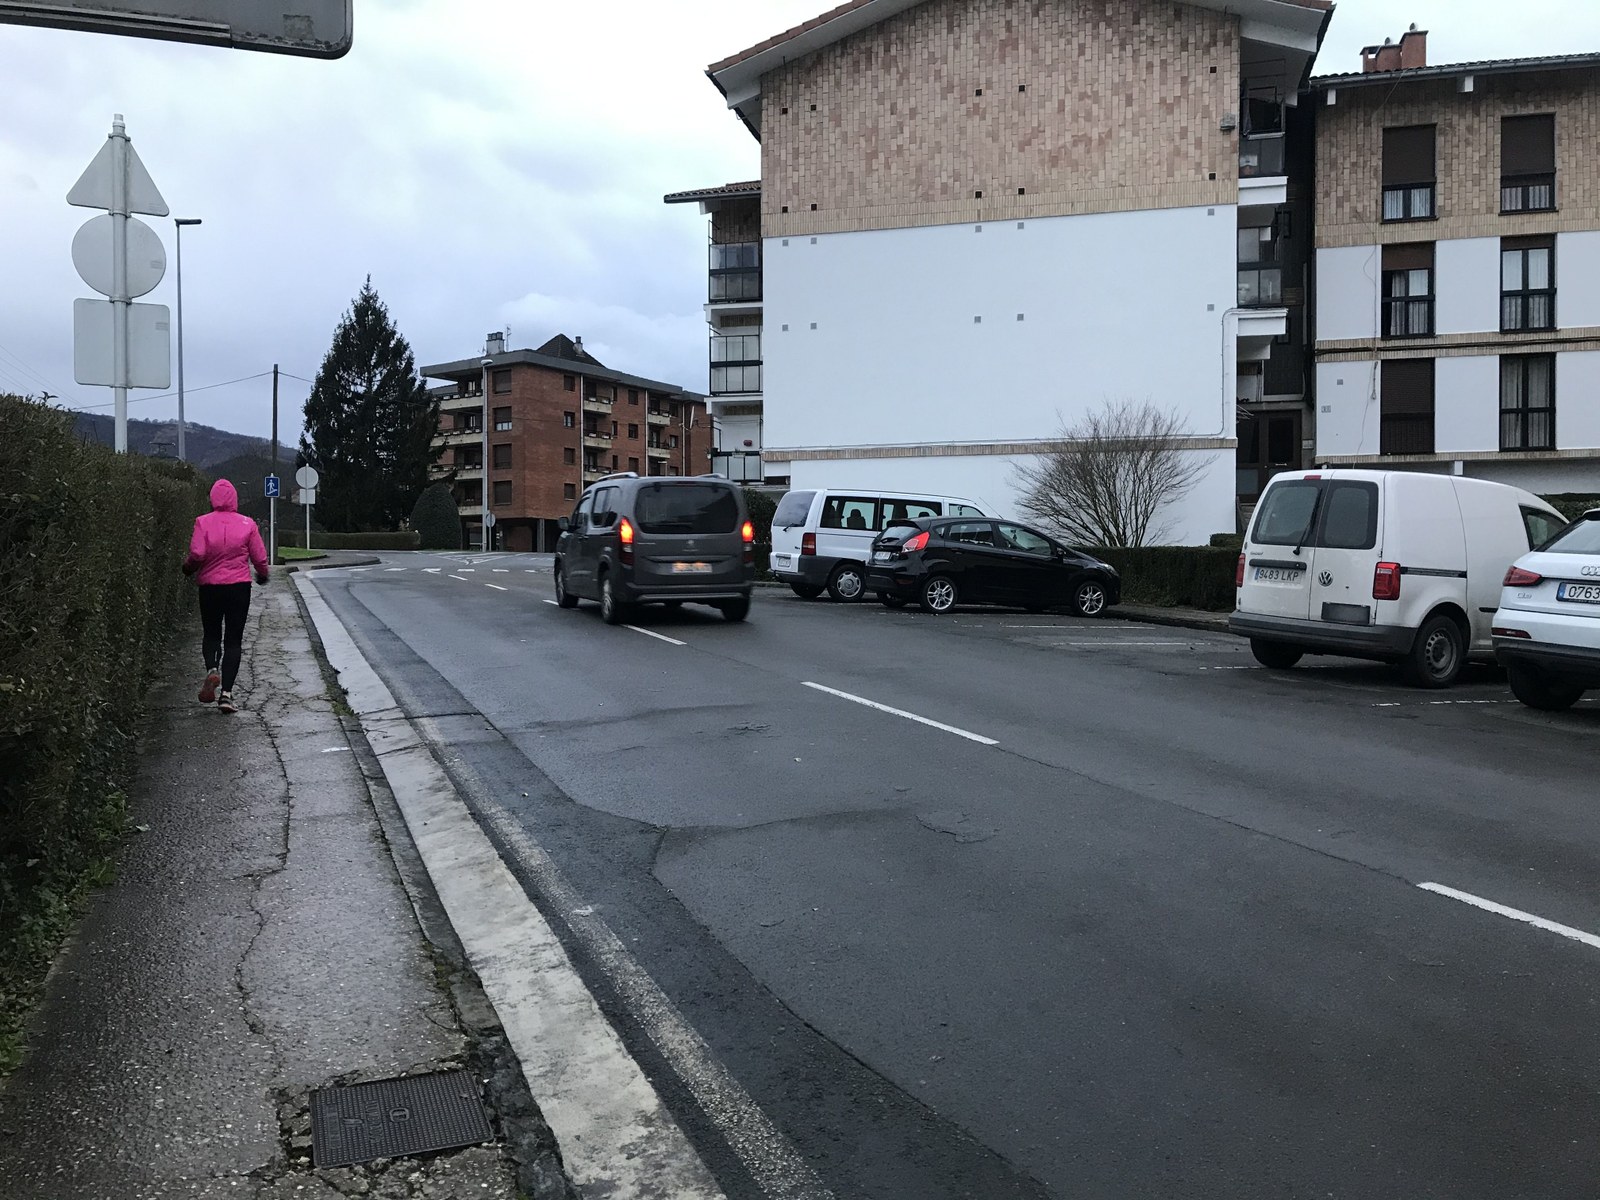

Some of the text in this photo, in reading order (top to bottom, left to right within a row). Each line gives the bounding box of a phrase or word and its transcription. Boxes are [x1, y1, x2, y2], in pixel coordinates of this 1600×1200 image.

[1259, 569, 1299, 581] 9483 LKP
[1568, 585, 1600, 600] 0763
